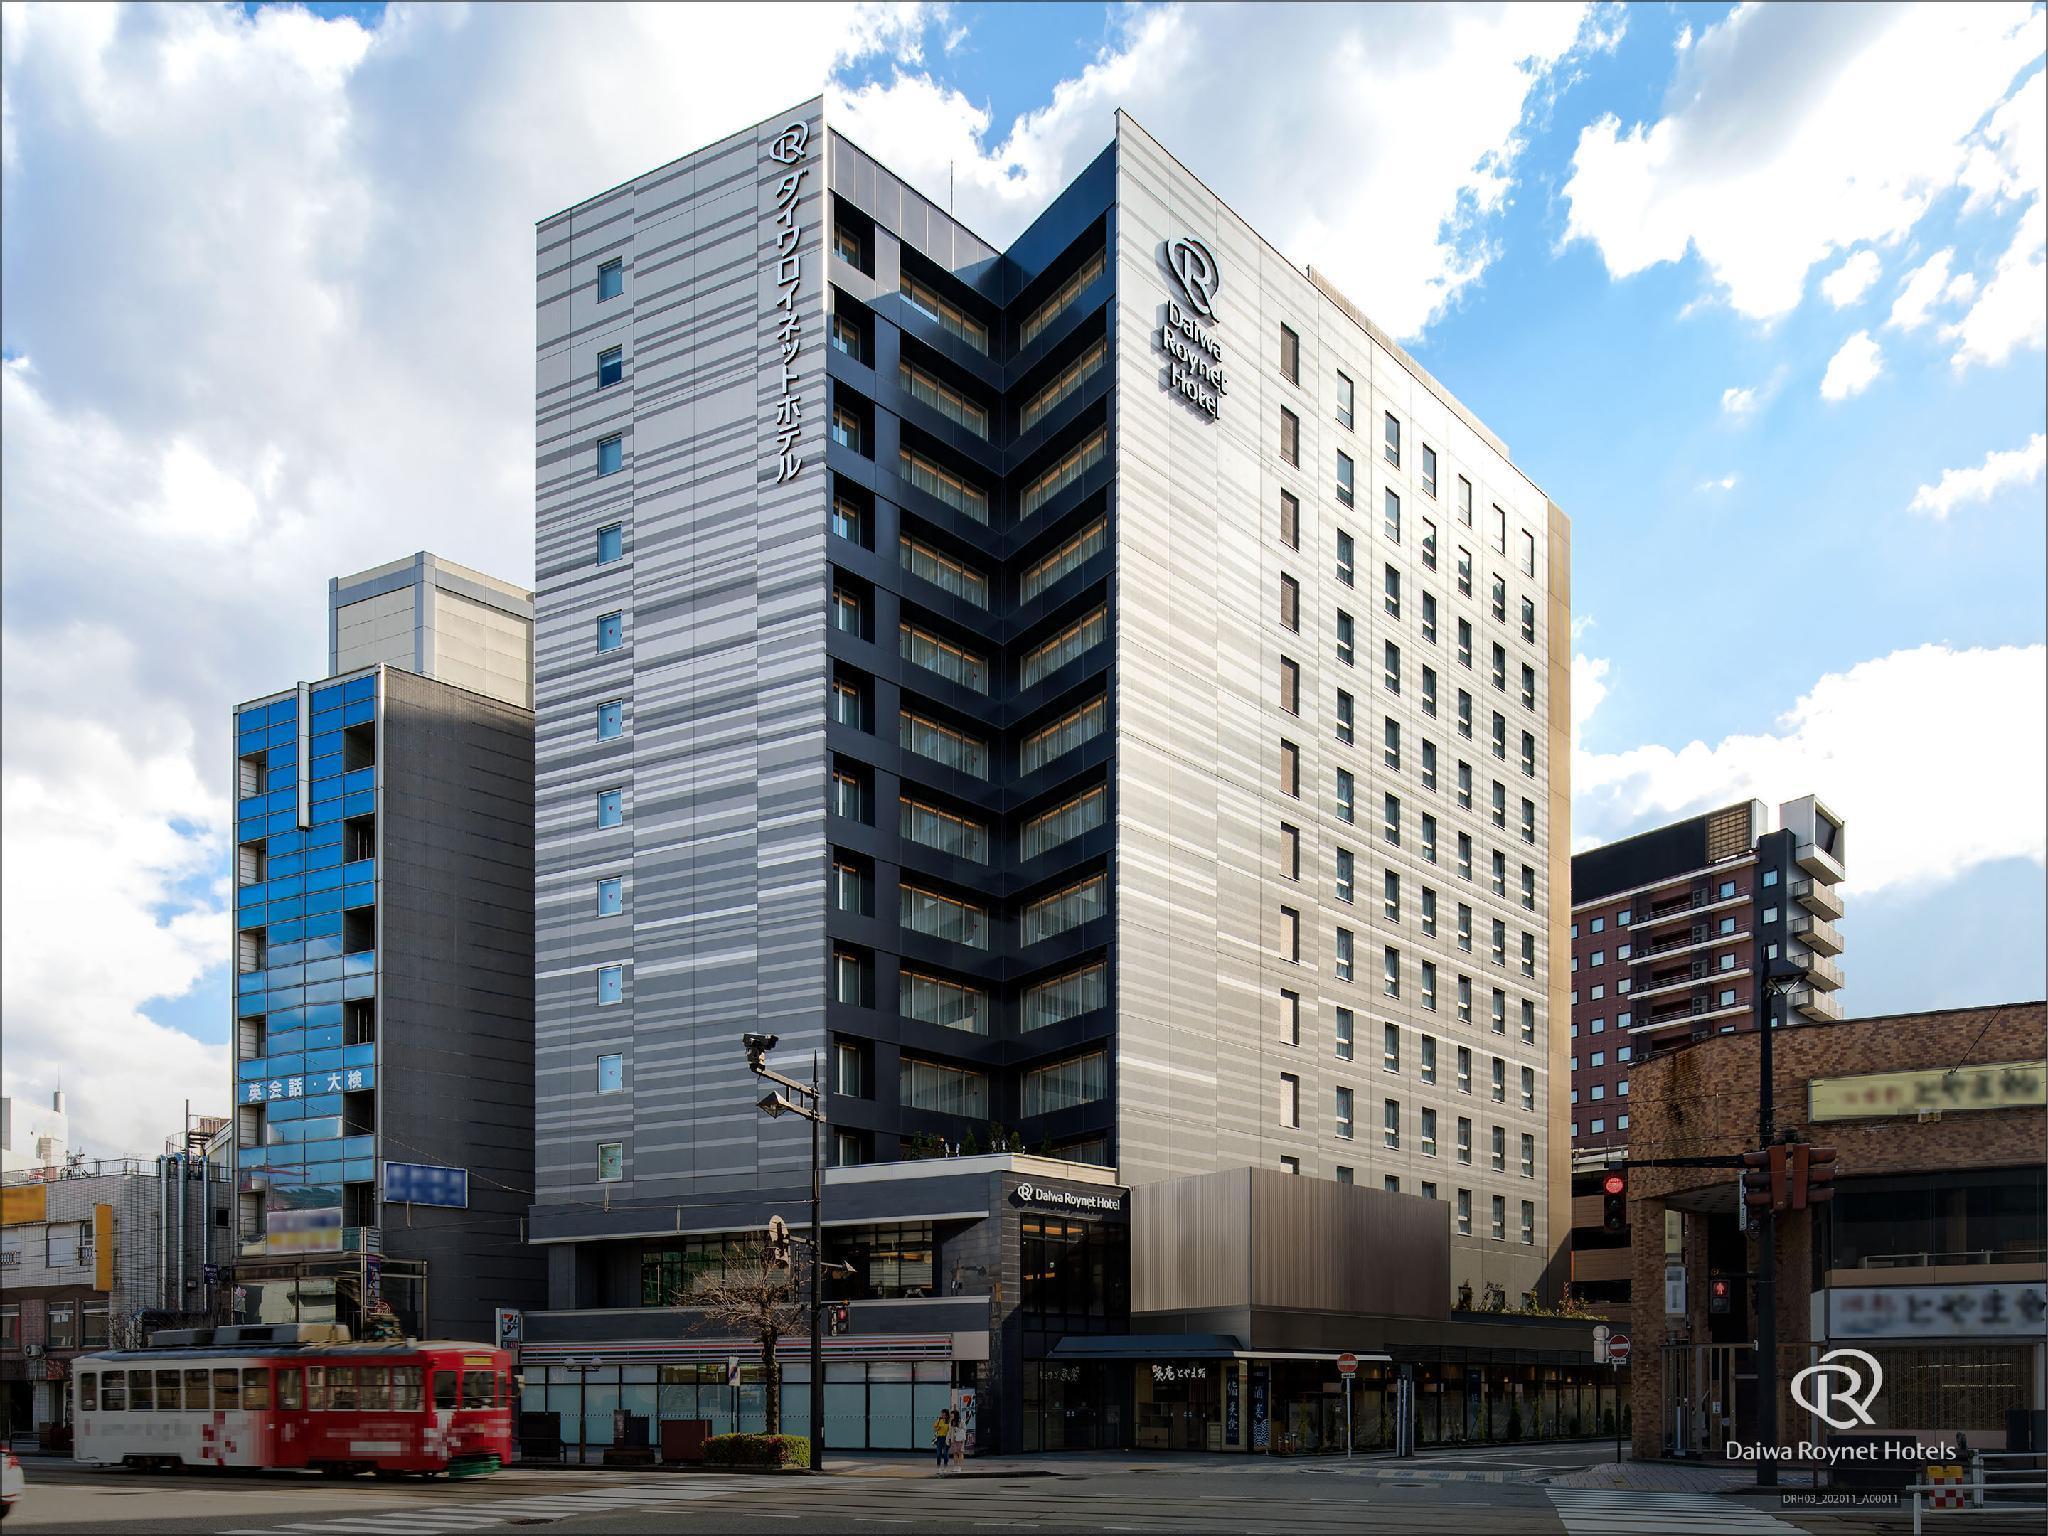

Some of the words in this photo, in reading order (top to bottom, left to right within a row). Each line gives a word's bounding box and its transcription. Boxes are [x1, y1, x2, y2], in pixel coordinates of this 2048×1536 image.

[776, 168, 809, 483] ダイワロイネットホテル
[1167, 299, 1222, 363] Daiwa
[1162, 324, 1227, 395] Roynet
[1170, 361, 1219, 420] Hotel
[1035, 1188, 1063, 1203] Daiwa
[1064, 1192, 1096, 1208] Roynet
[1097, 1198, 1120, 1211] Hotel
